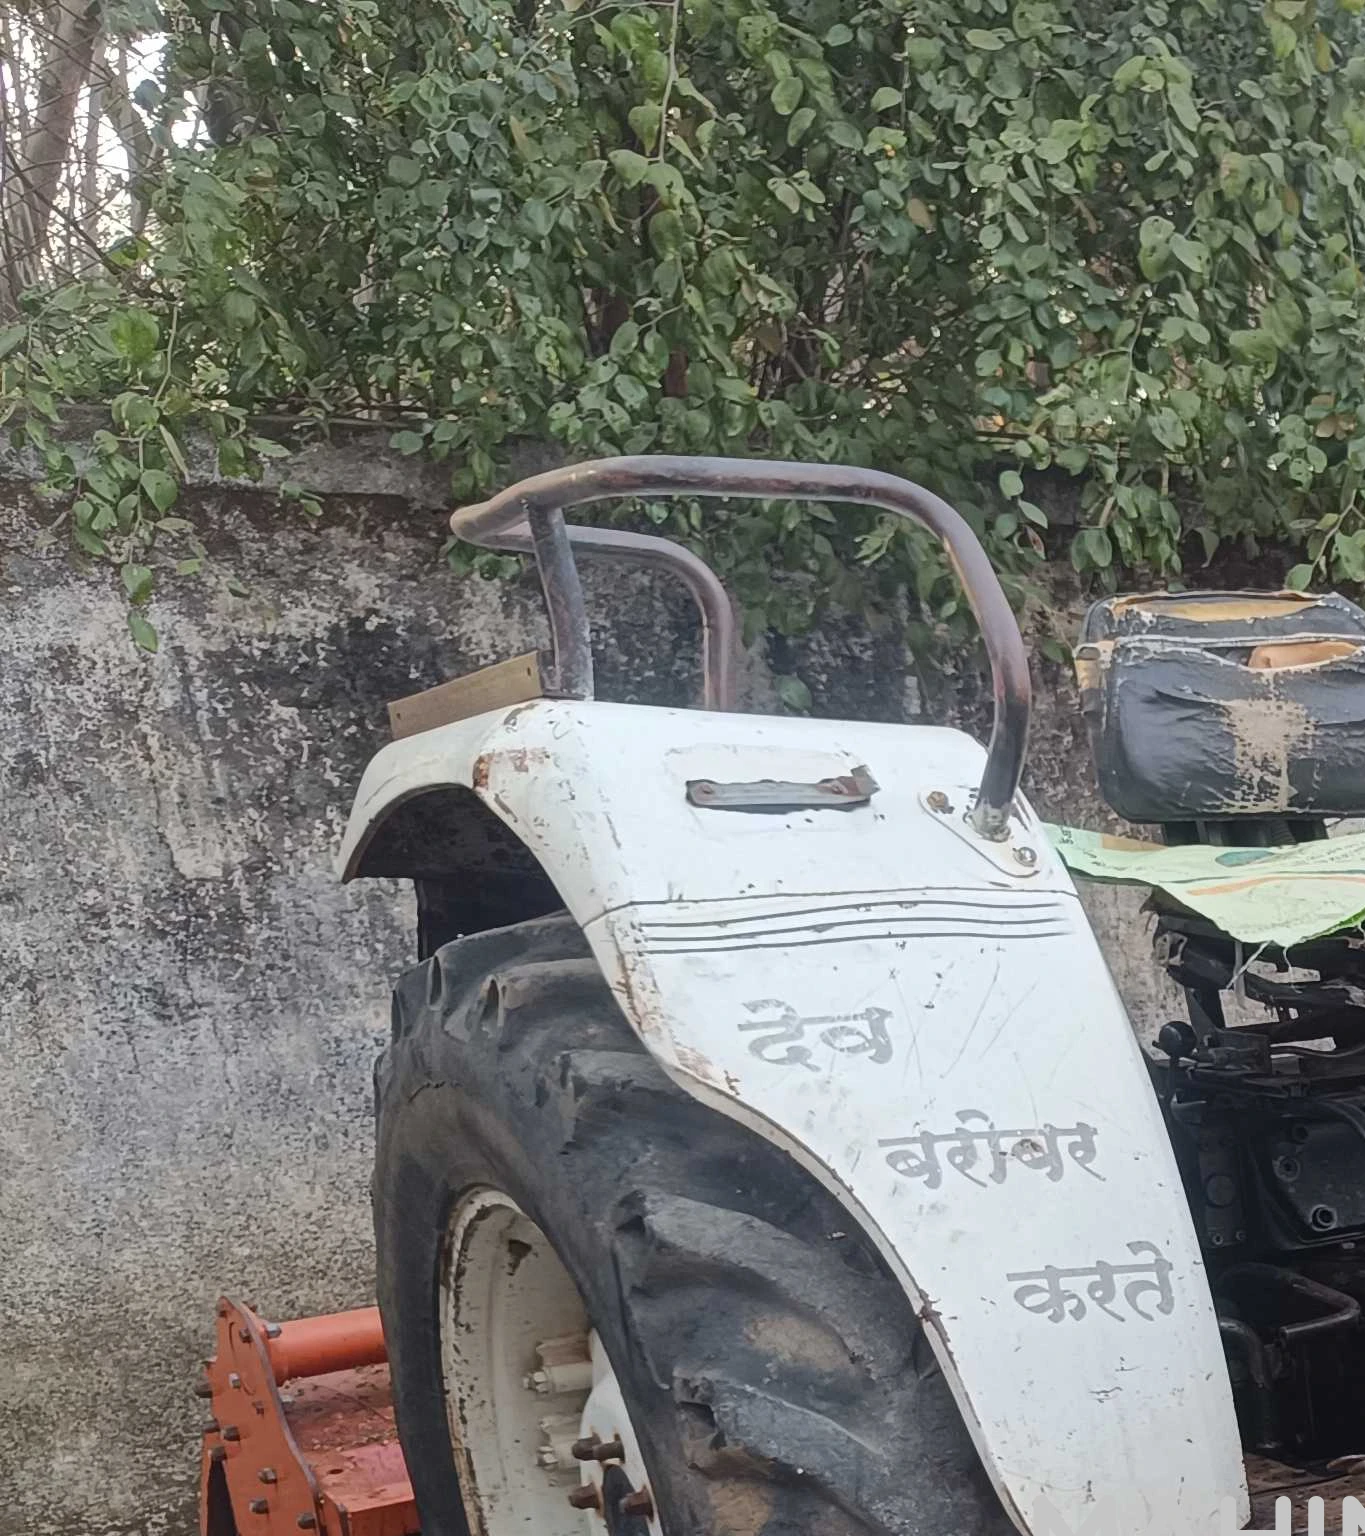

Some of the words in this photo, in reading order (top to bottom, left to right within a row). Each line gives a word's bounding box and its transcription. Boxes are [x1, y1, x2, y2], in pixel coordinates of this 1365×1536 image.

[737, 998, 894, 1072] देव
[877, 1108, 1107, 1190] बरोबर
[1006, 1240, 1175, 1324] करते
